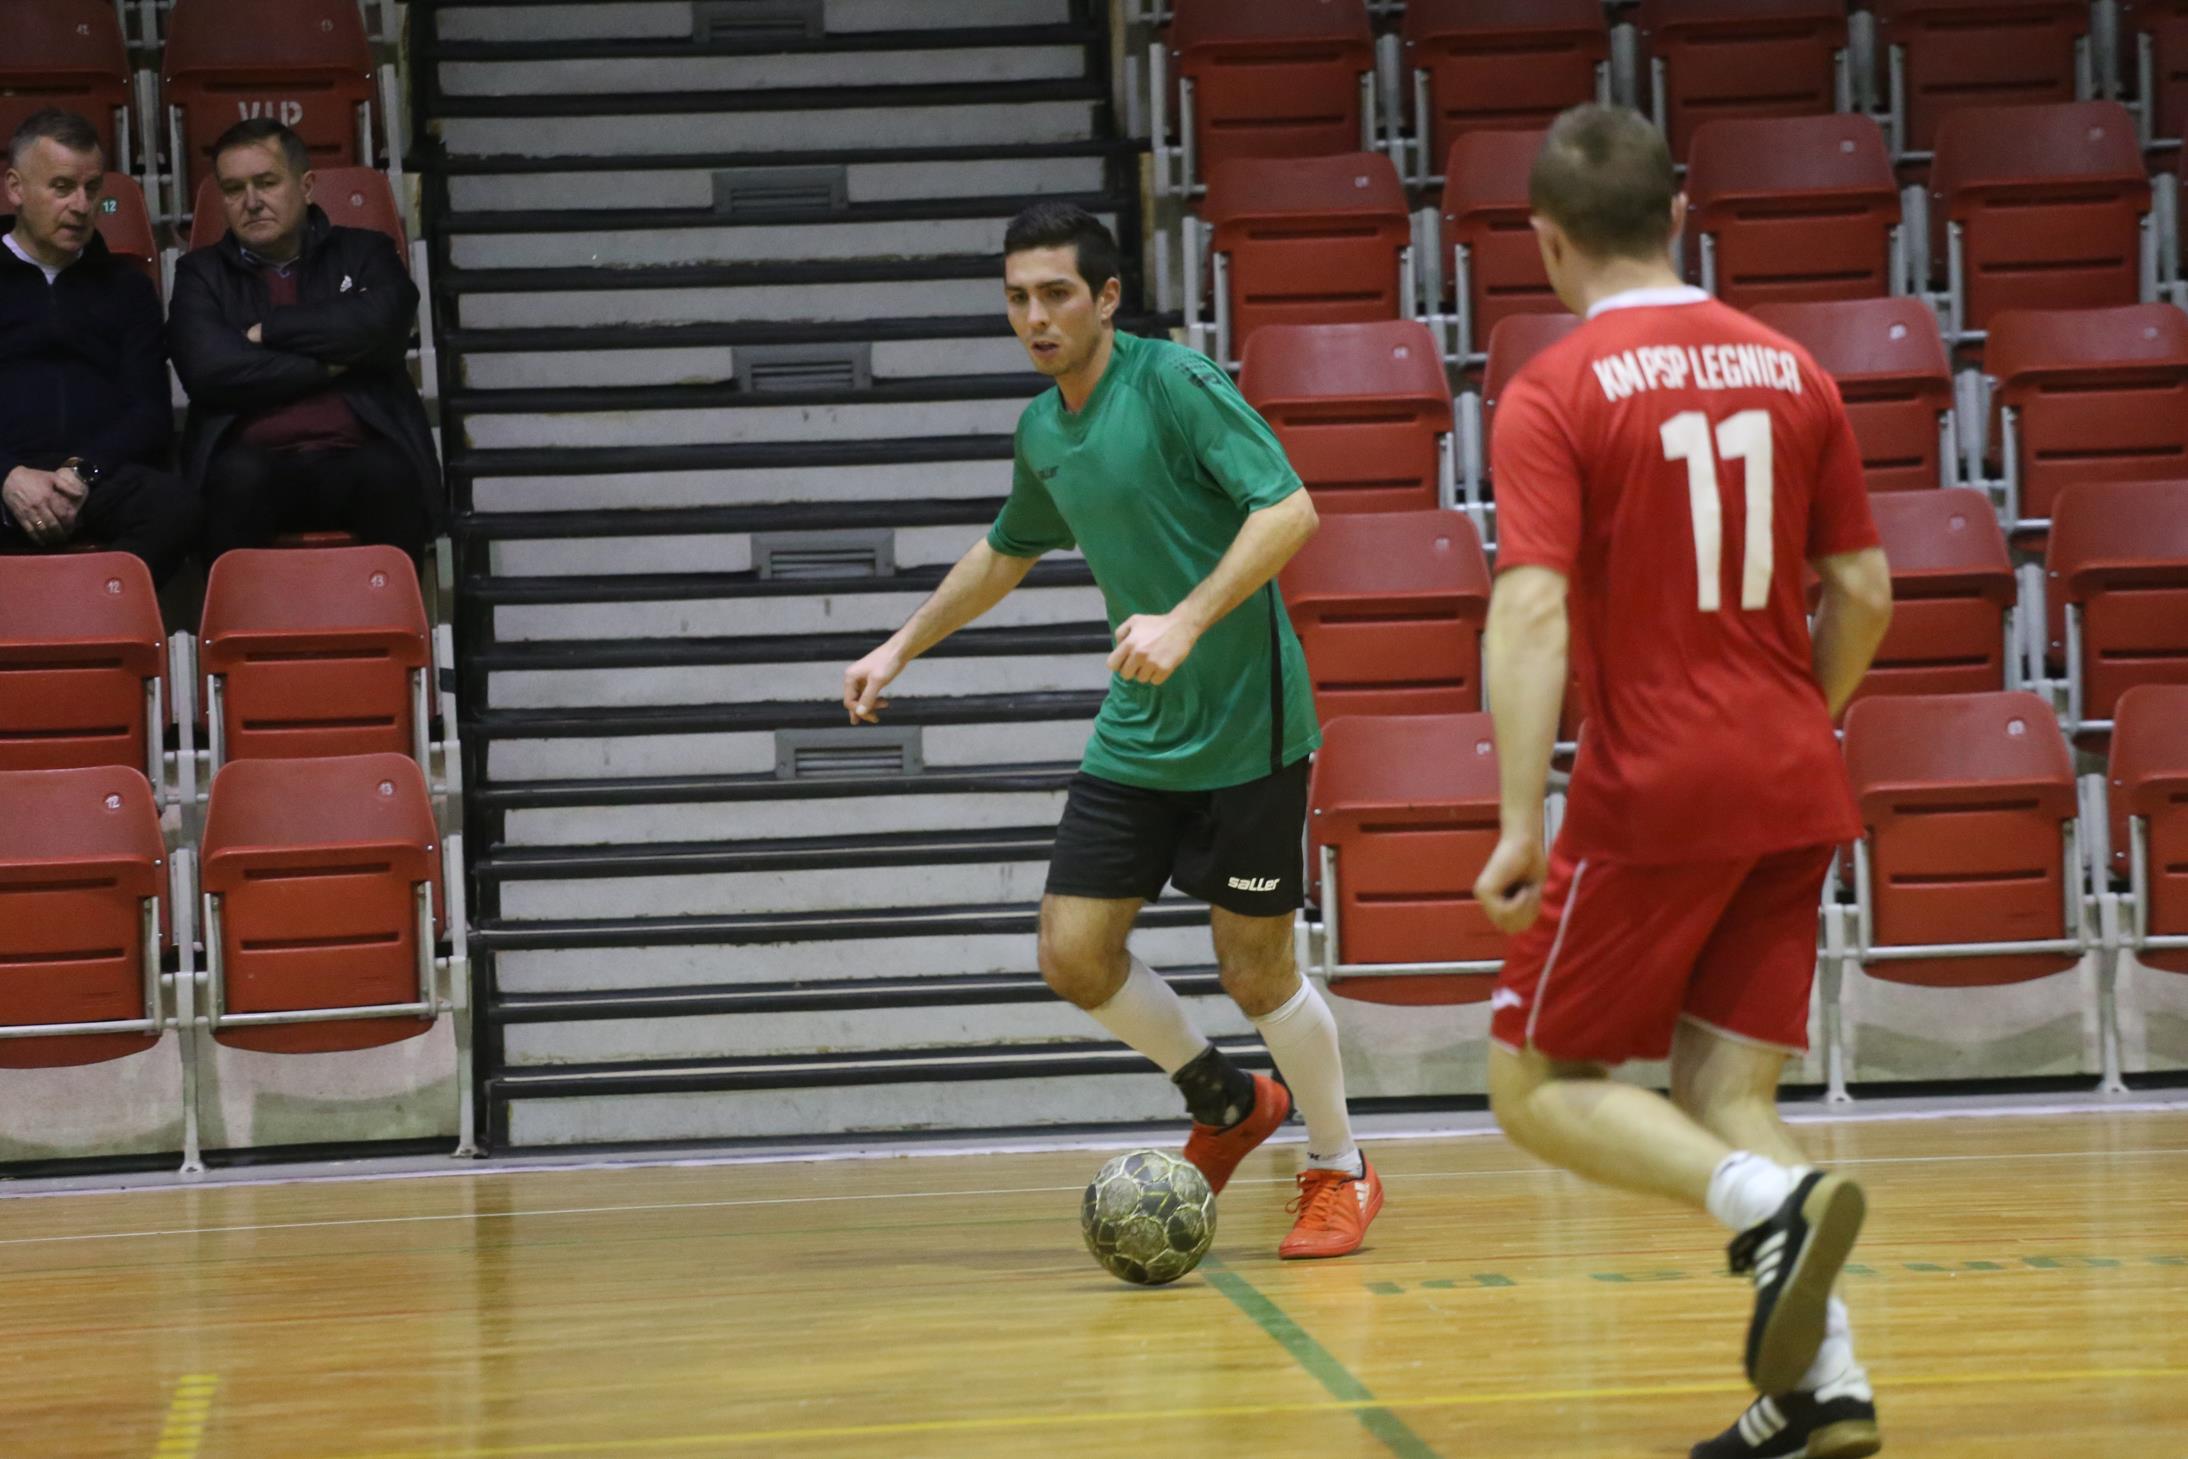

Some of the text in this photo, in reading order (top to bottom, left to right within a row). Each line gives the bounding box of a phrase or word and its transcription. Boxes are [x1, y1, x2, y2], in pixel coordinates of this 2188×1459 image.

[102, 200, 118, 214] 12
[1688, 344, 1802, 394] LEGNICA
[1659, 409, 1774, 612] 11
[107, 580, 121, 594] 12
[105, 795, 121, 810] 12
